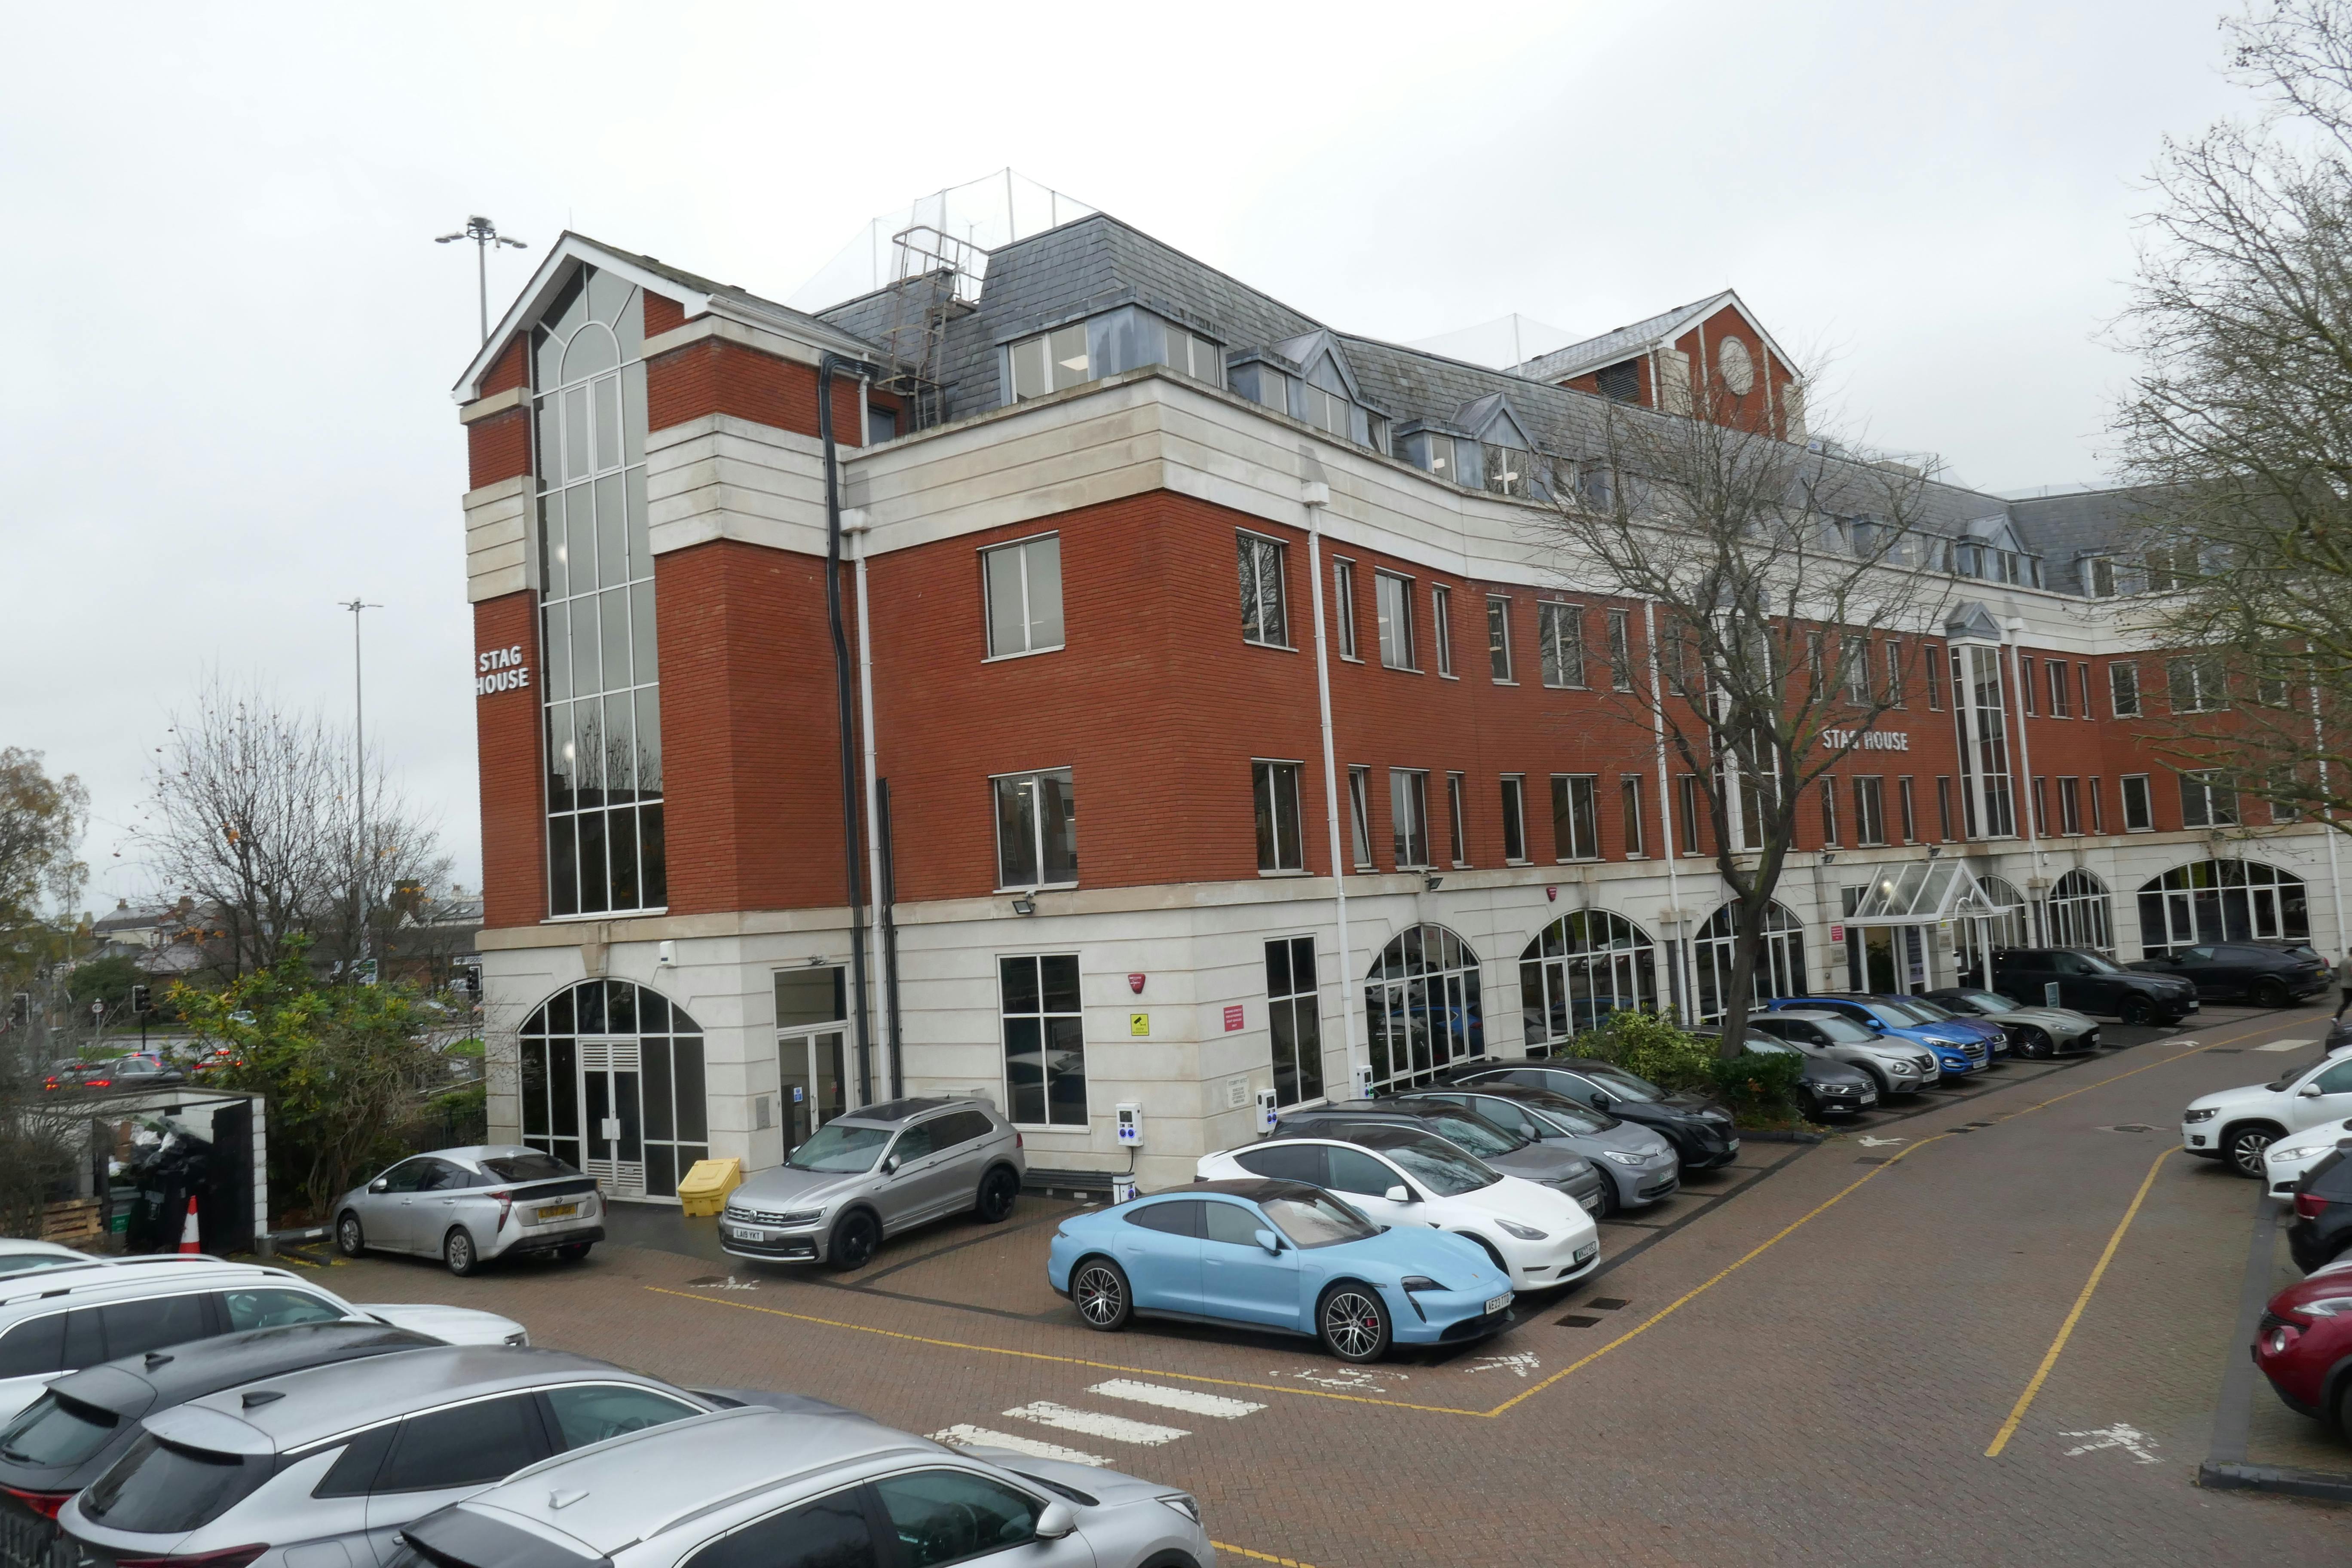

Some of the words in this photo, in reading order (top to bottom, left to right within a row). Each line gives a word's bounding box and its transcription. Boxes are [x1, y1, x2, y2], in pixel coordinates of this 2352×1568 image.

[479, 646, 522, 672] STAG
[475, 667, 529, 696] HOUSE
[1863, 731, 1909, 751] HOUSE
[736, 1230, 748, 1238] LA19
[749, 1231, 760, 1240] YKT
[1488, 1298, 1501, 1311] AE23
